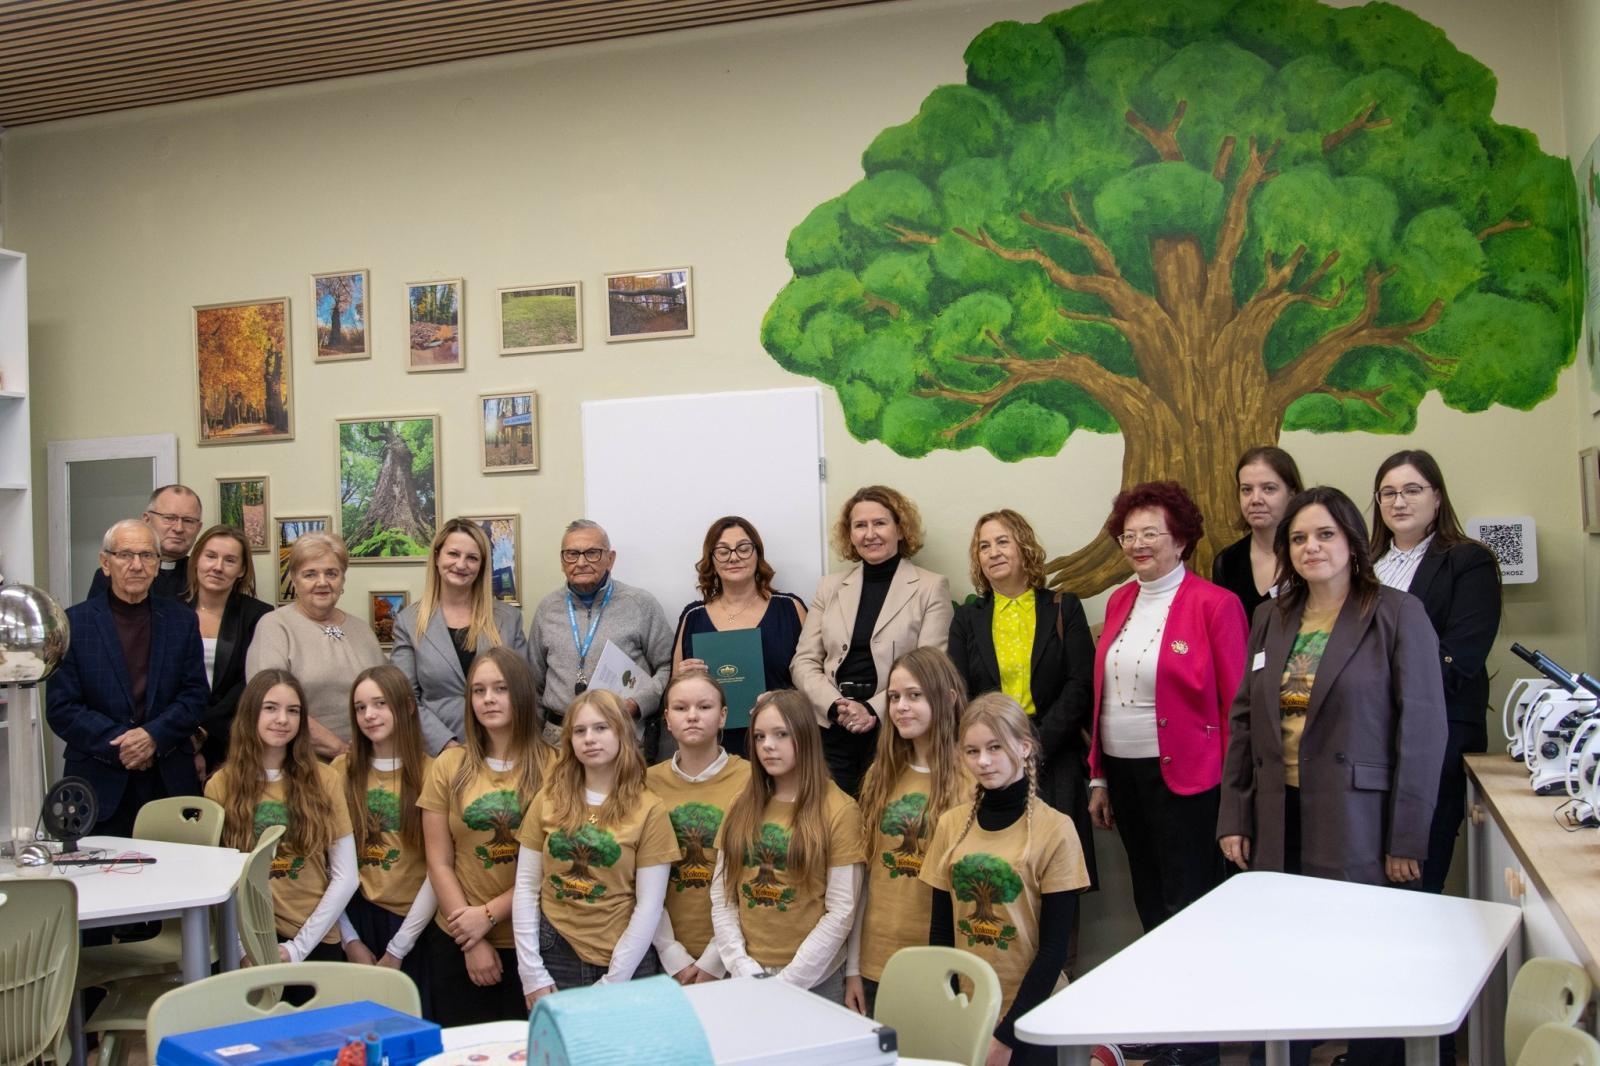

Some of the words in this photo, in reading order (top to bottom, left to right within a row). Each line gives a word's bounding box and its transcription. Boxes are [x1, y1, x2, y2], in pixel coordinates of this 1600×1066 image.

[492, 849, 516, 857] Kokosz
[897, 858, 921, 868] Kokosz
[683, 870, 709, 878] Kokosz
[566, 882, 589, 891] Kokosz
[755, 889, 778, 897] Kokosz
[974, 926, 997, 935] Kokosz
